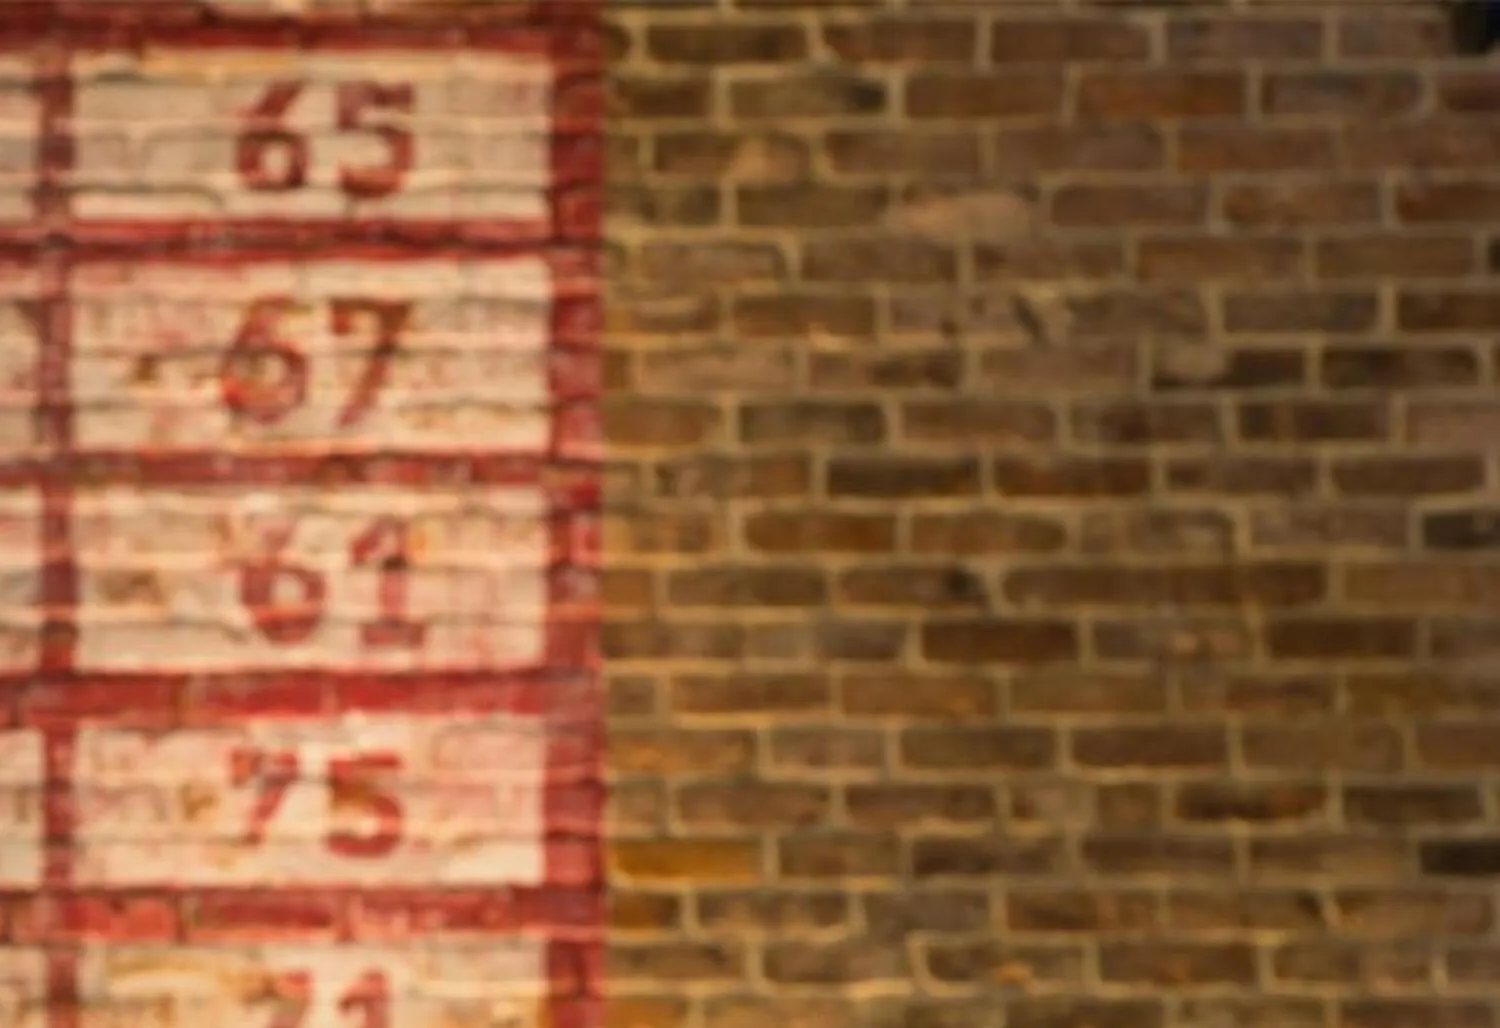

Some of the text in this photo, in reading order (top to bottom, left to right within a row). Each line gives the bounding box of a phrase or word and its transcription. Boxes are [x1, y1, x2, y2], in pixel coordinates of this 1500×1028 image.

[234, 82, 416, 198] 65
[221, 296, 414, 427] 67
[238, 522, 426, 648] 61
[230, 745, 406, 860] 75
